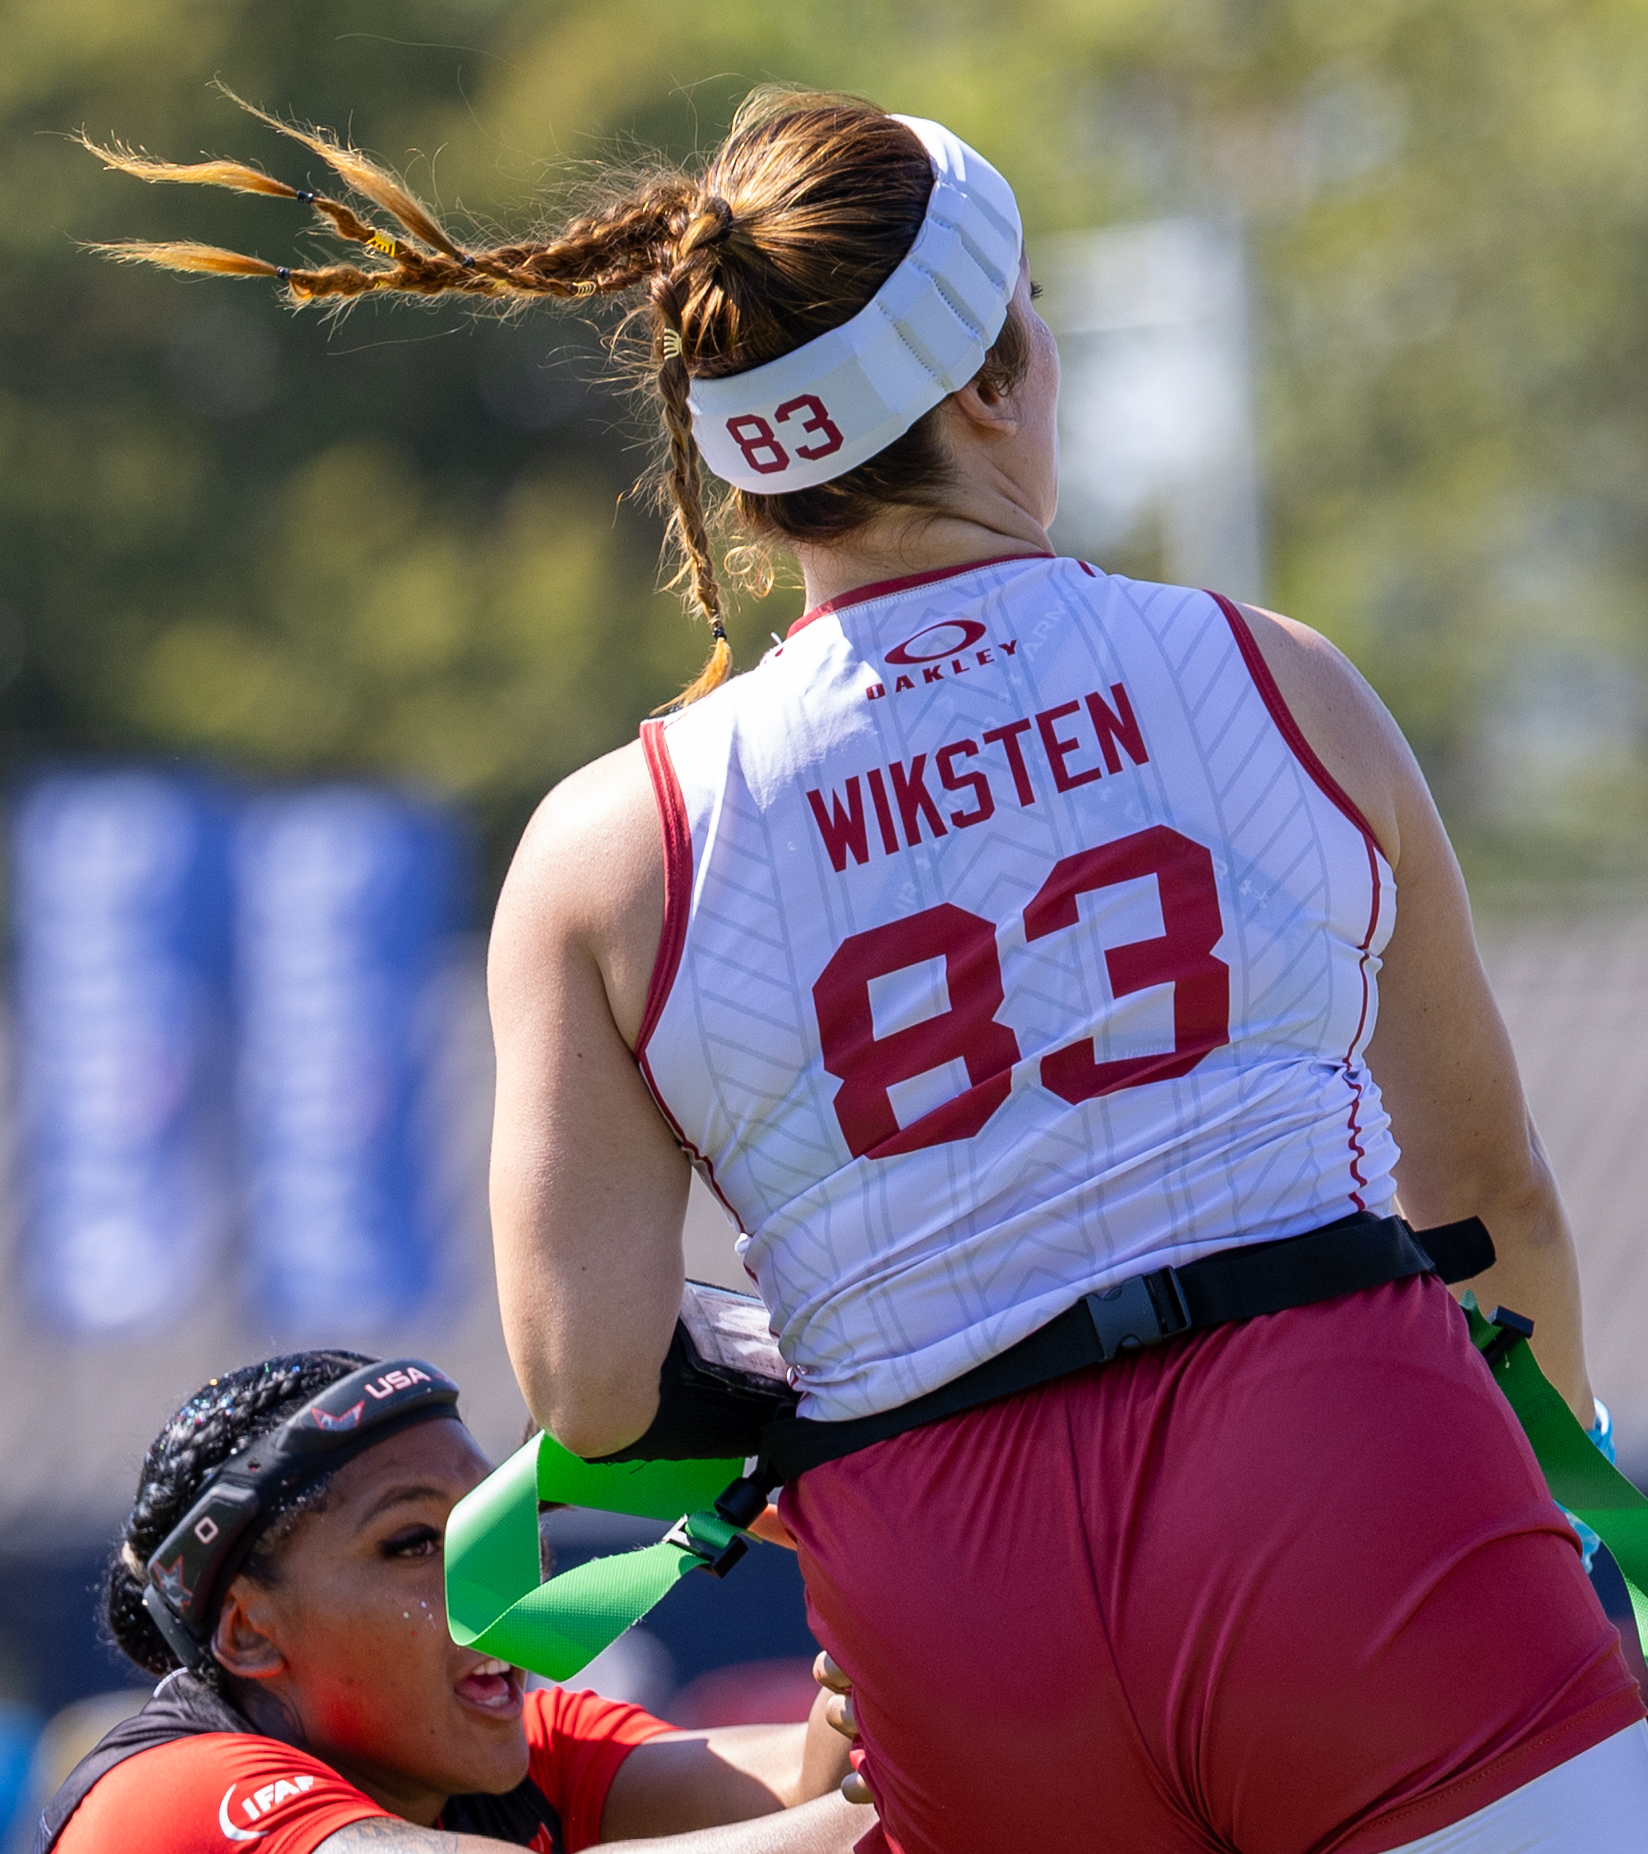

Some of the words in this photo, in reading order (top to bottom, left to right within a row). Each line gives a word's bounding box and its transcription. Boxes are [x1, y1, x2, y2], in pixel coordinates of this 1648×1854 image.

[726, 393, 844, 474] 83
[866, 639, 1018, 701] OAKLEY
[806, 682, 1150, 873] WIKSTEN
[812, 823, 1230, 1160] 83
[365, 1367, 431, 1400] USA
[241, 1775, 314, 1821] IFAF
